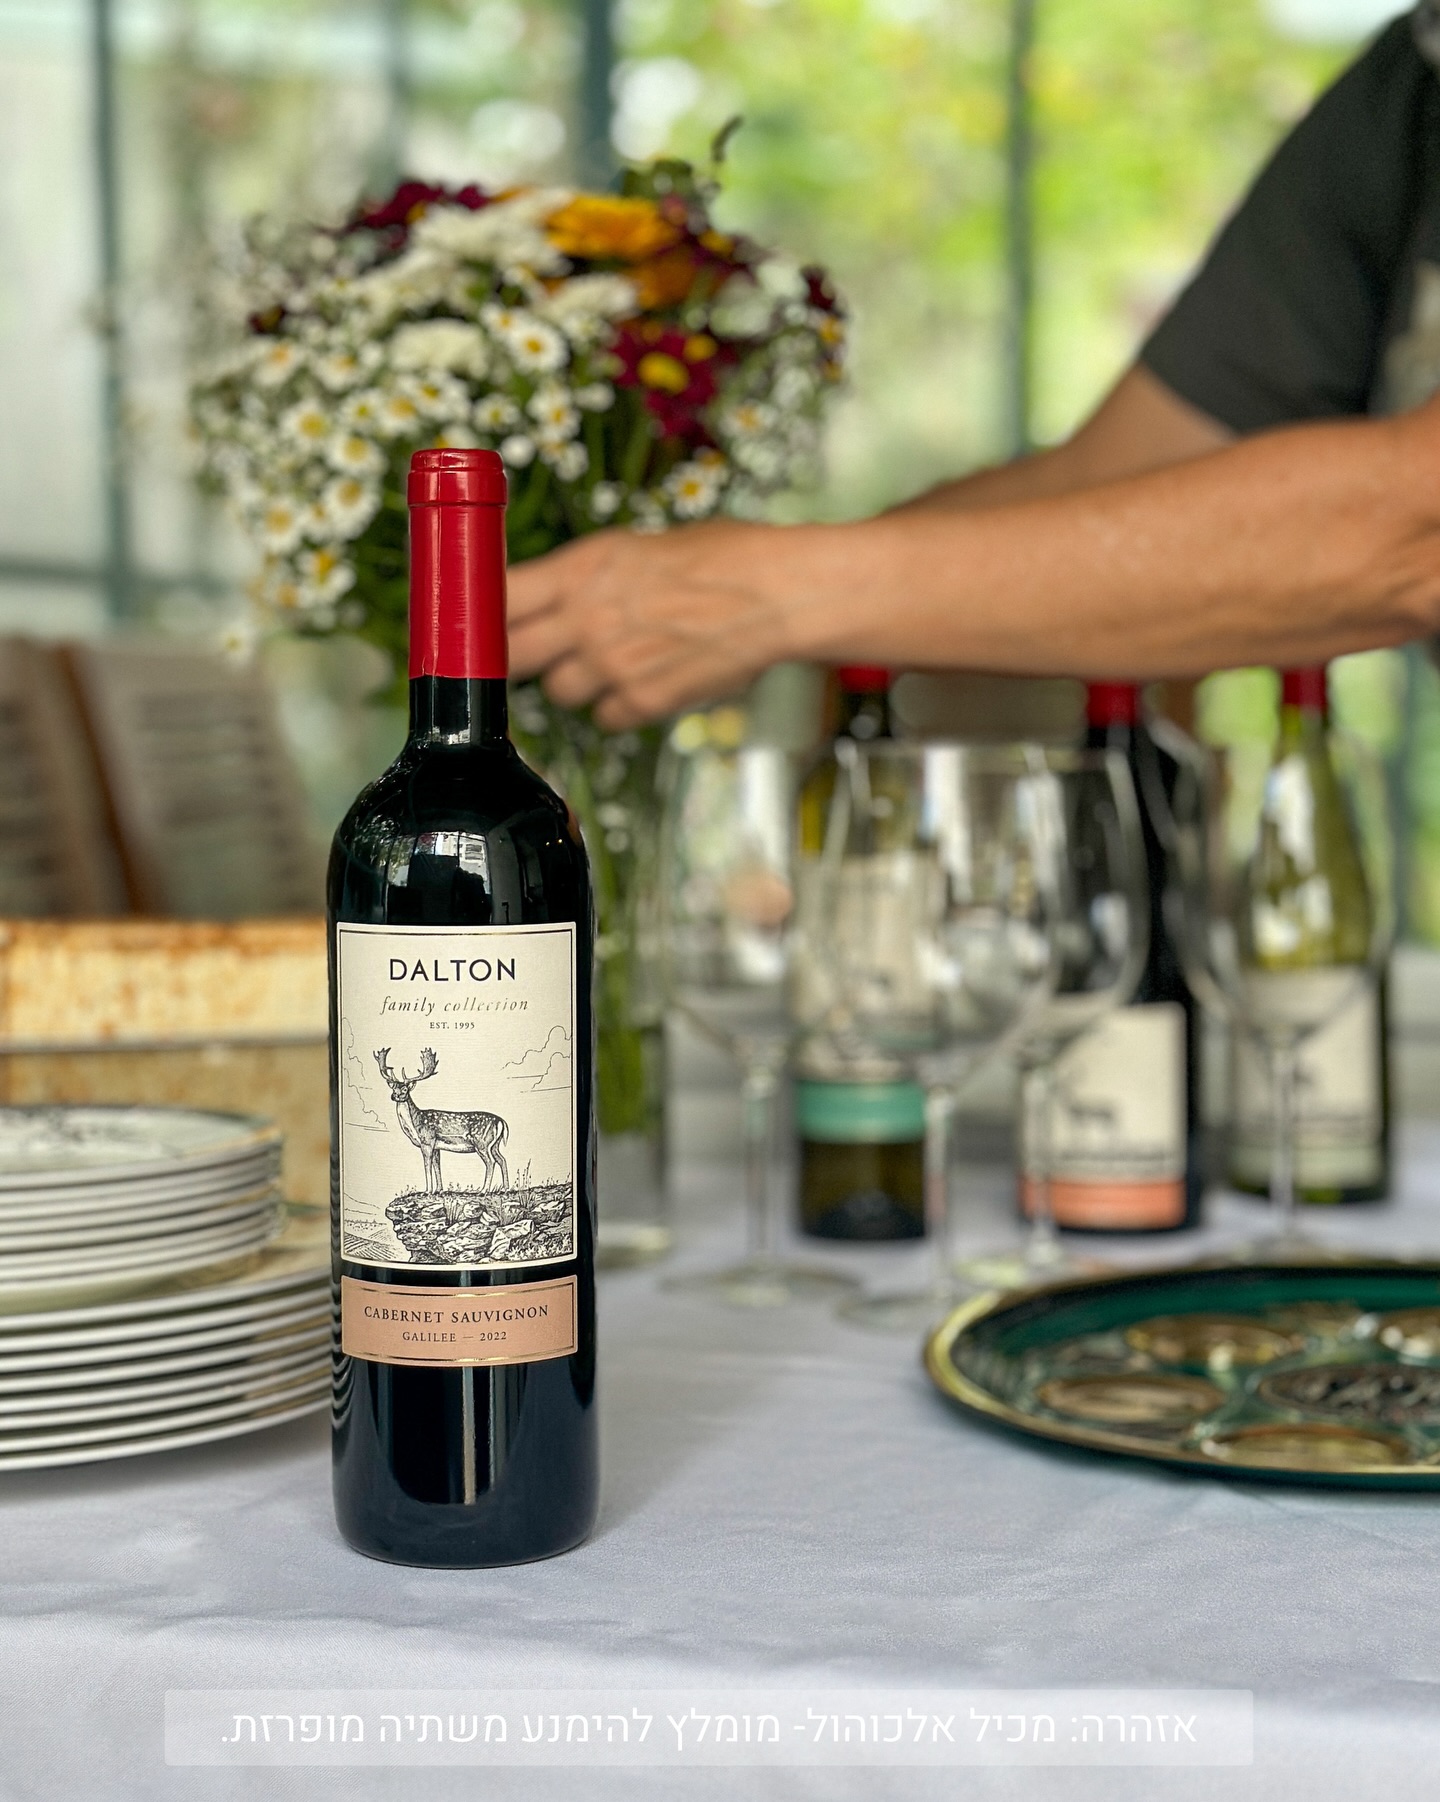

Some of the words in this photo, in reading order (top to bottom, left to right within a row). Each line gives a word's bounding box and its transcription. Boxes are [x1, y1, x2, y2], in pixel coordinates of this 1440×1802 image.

[389, 958, 516, 982] DALTON
[379, 995, 436, 1017] family
[443, 997, 529, 1013] collection
[429, 1021, 450, 1030] EST.
[454, 1021, 475, 1030] 1995
[364, 1305, 444, 1324] CABERNET
[451, 1305, 549, 1324] SAUVIGNON
[402, 1331, 457, 1343] GALILEE
[479, 1331, 507, 1343] 2022
